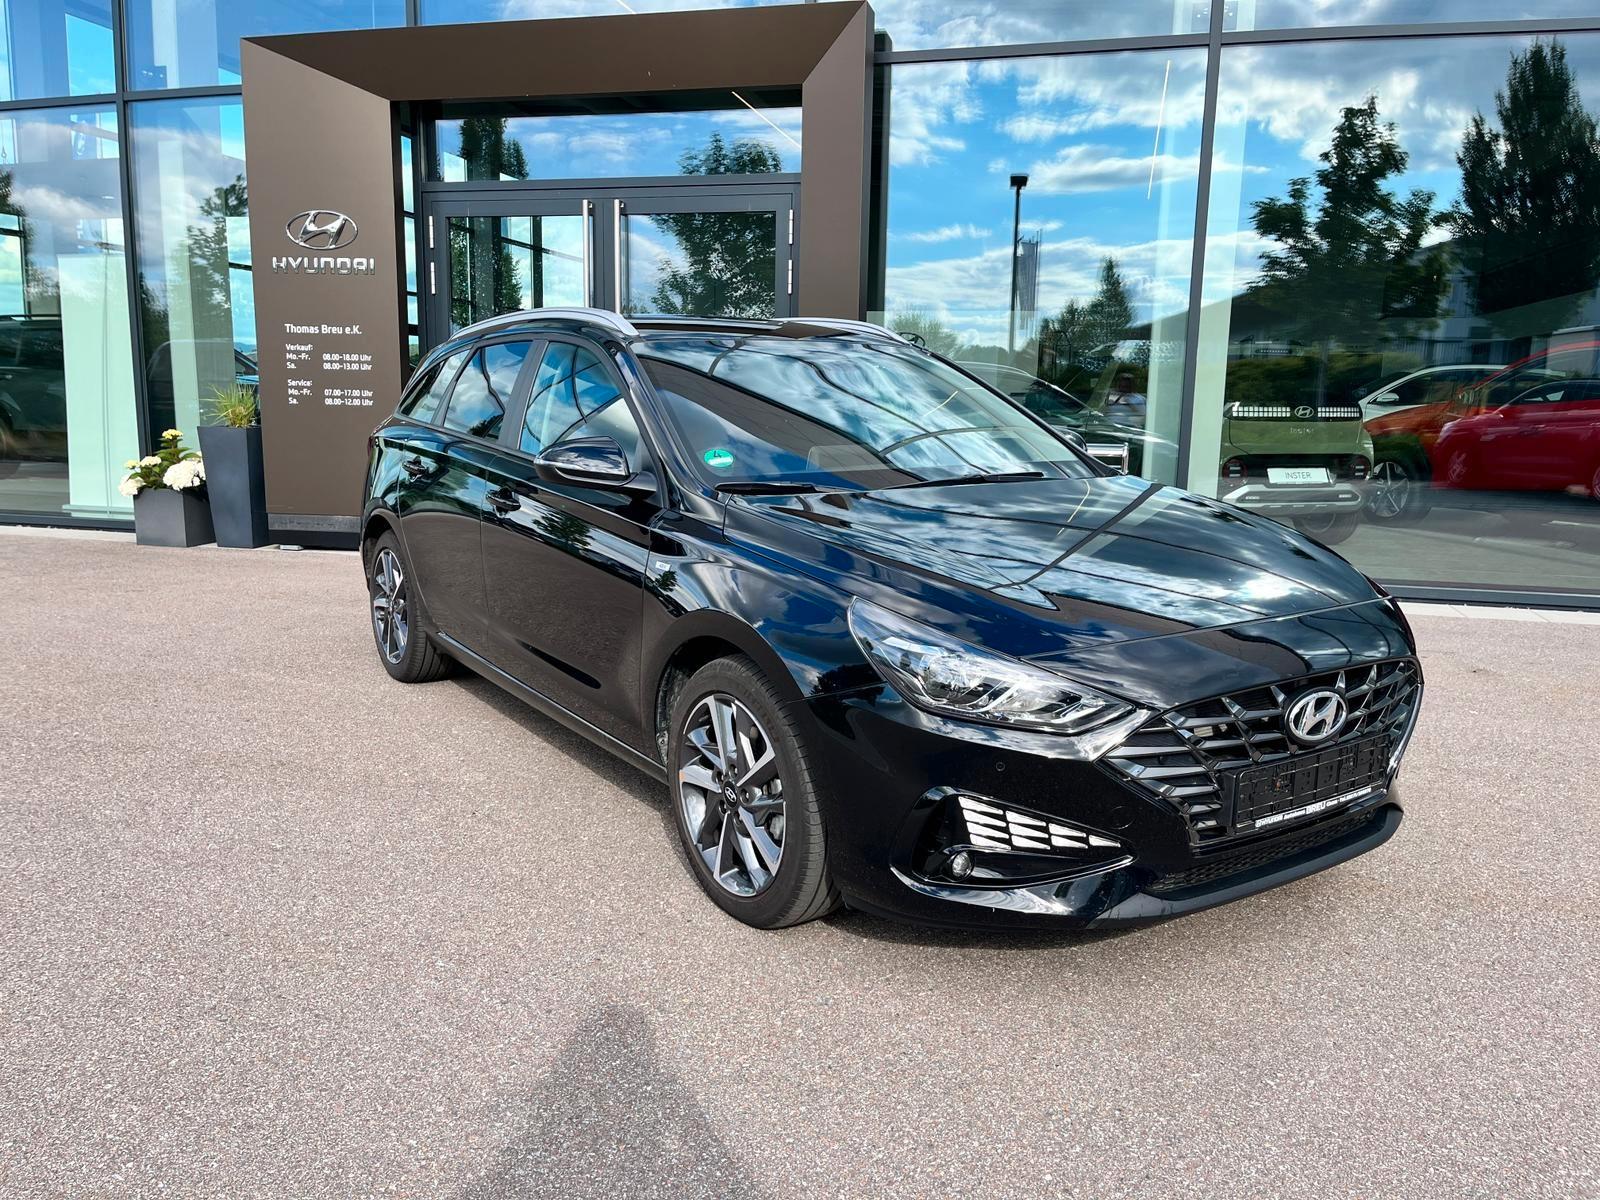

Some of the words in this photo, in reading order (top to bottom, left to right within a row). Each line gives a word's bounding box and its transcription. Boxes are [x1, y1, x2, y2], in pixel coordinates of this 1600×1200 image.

[272, 256, 375, 275] HYUNDAI
[284, 323, 319, 334] Thomas
[321, 324, 343, 334] Breu
[345, 324, 362, 334] e.K.
[285, 343, 313, 351] Verkauf:
[286, 352, 311, 360] Mo.-Fr.
[322, 353, 359, 361] 08.00-18.00
[286, 361, 296, 369] Sa.
[323, 362, 359, 370] 08.00-13.00
[288, 388, 312, 396] Mo.-Fr.
[324, 389, 360, 397] 07.00-17.00
[361, 389, 373, 397] Uhr
[324, 398, 360, 406] 08.00-12.00
[361, 398, 374, 406] Uhr
[714, 450, 722, 458] 4
[1285, 471, 1312, 480] INSTER
[1306, 801, 1326, 814] BREU
